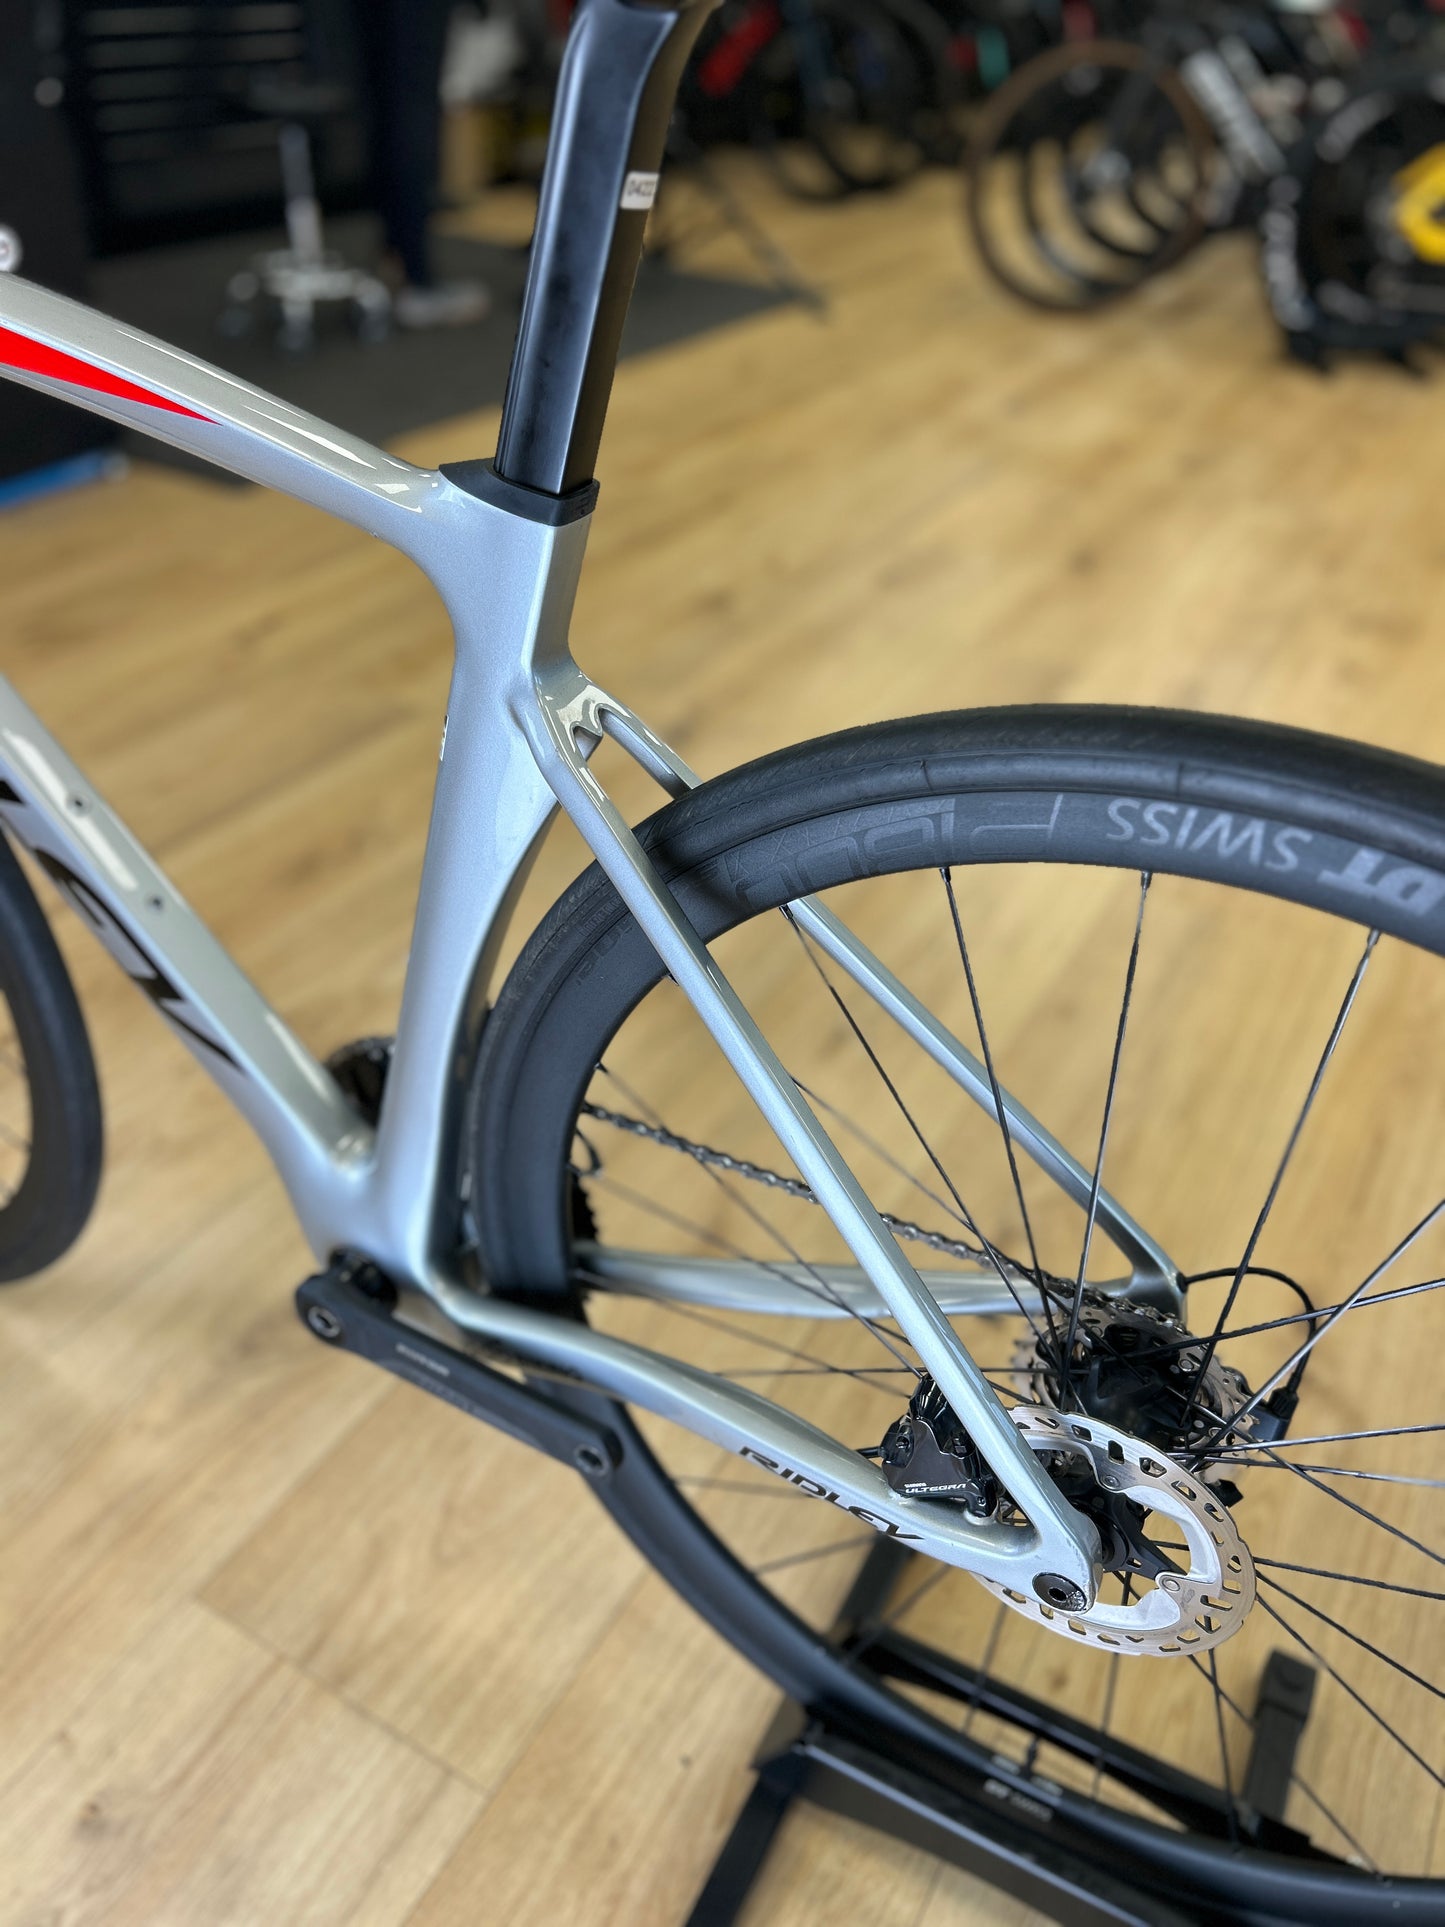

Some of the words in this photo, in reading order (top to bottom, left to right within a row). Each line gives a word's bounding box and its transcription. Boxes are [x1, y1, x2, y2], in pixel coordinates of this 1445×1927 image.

[1106, 798, 1314, 873] SWISS
[1317, 847, 1445, 916] DT
[738, 1446, 925, 1541] RIDLEY
[905, 1483, 967, 1494] ULTEGRA
